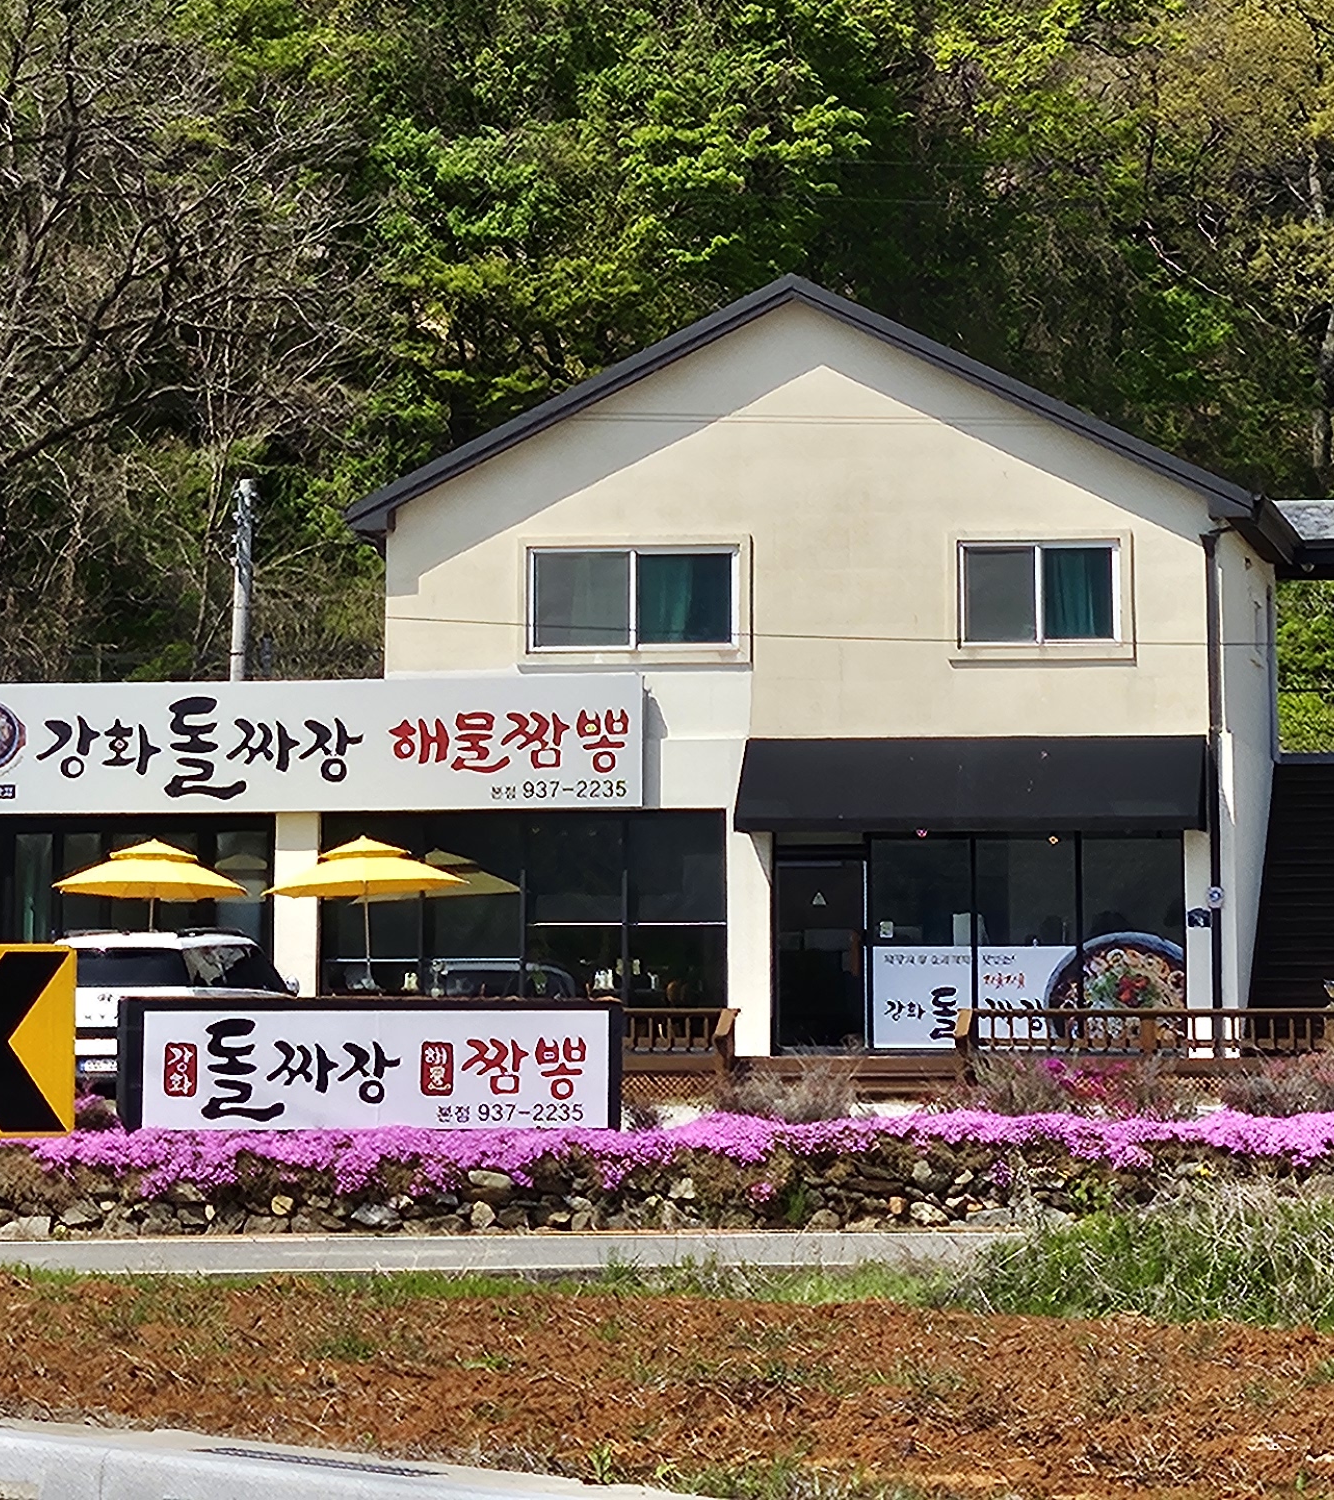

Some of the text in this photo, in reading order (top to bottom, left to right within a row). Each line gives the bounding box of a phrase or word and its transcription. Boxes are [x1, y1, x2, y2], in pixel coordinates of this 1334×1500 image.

[387, 707, 630, 774] 해물짬뽕
[522, 779, 628, 799] 937-2235
[167, 1046, 194, 1095] 강화
[200, 1017, 402, 1122] 돌짜장
[460, 1036, 587, 1101] 짬뽕
[477, 1102, 585, 1122] 937-2235
